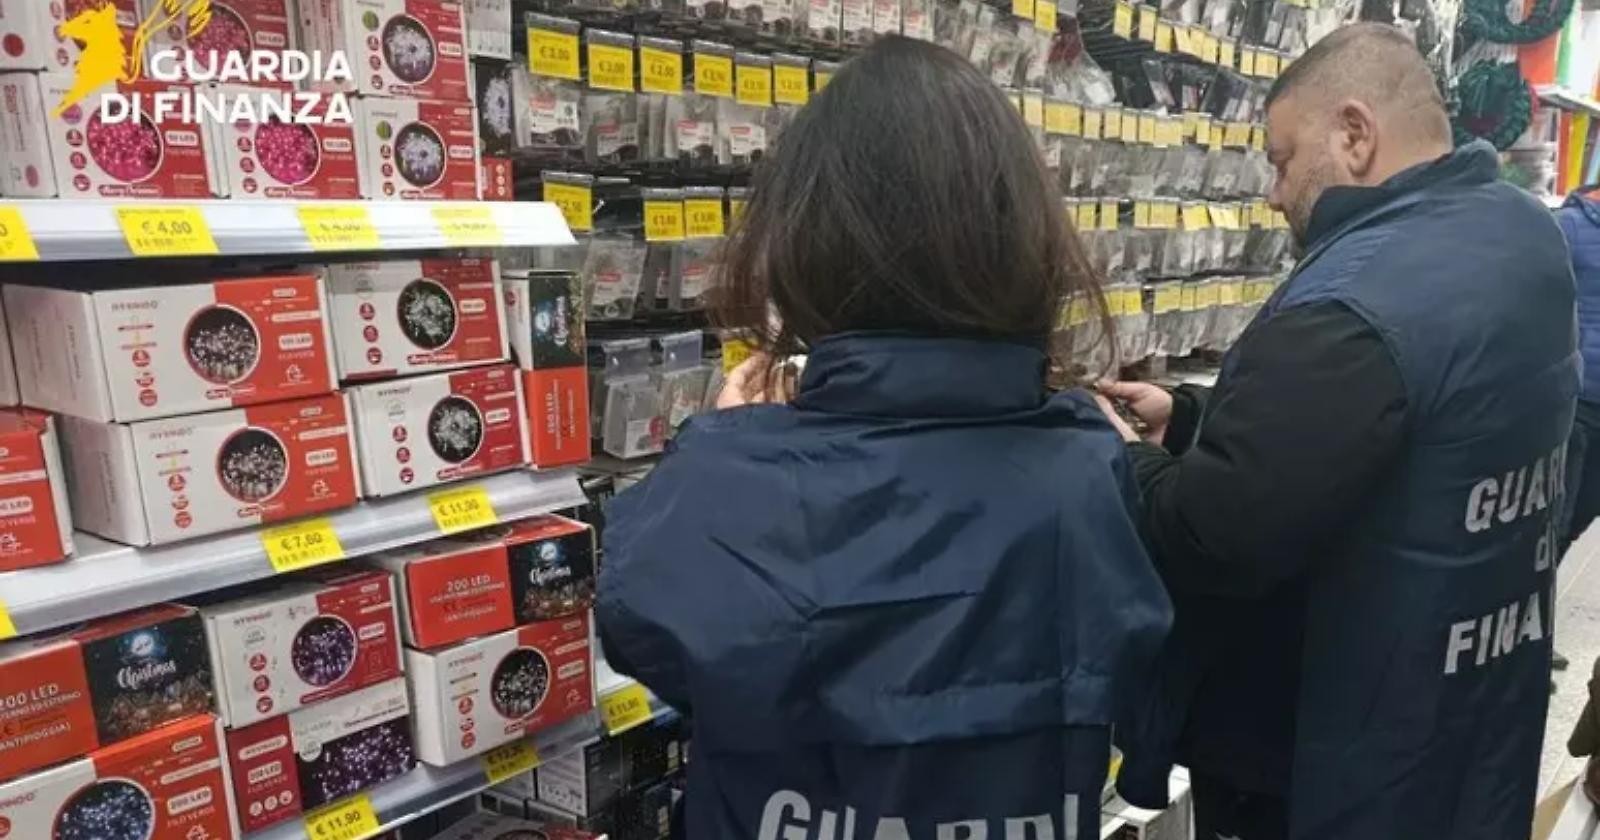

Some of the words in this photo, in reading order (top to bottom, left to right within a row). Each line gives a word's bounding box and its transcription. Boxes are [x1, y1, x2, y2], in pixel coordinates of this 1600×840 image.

[157, 220, 193, 238] 4,00
[30, 682, 59, 700] LED
[328, 809, 361, 831] 11,90
